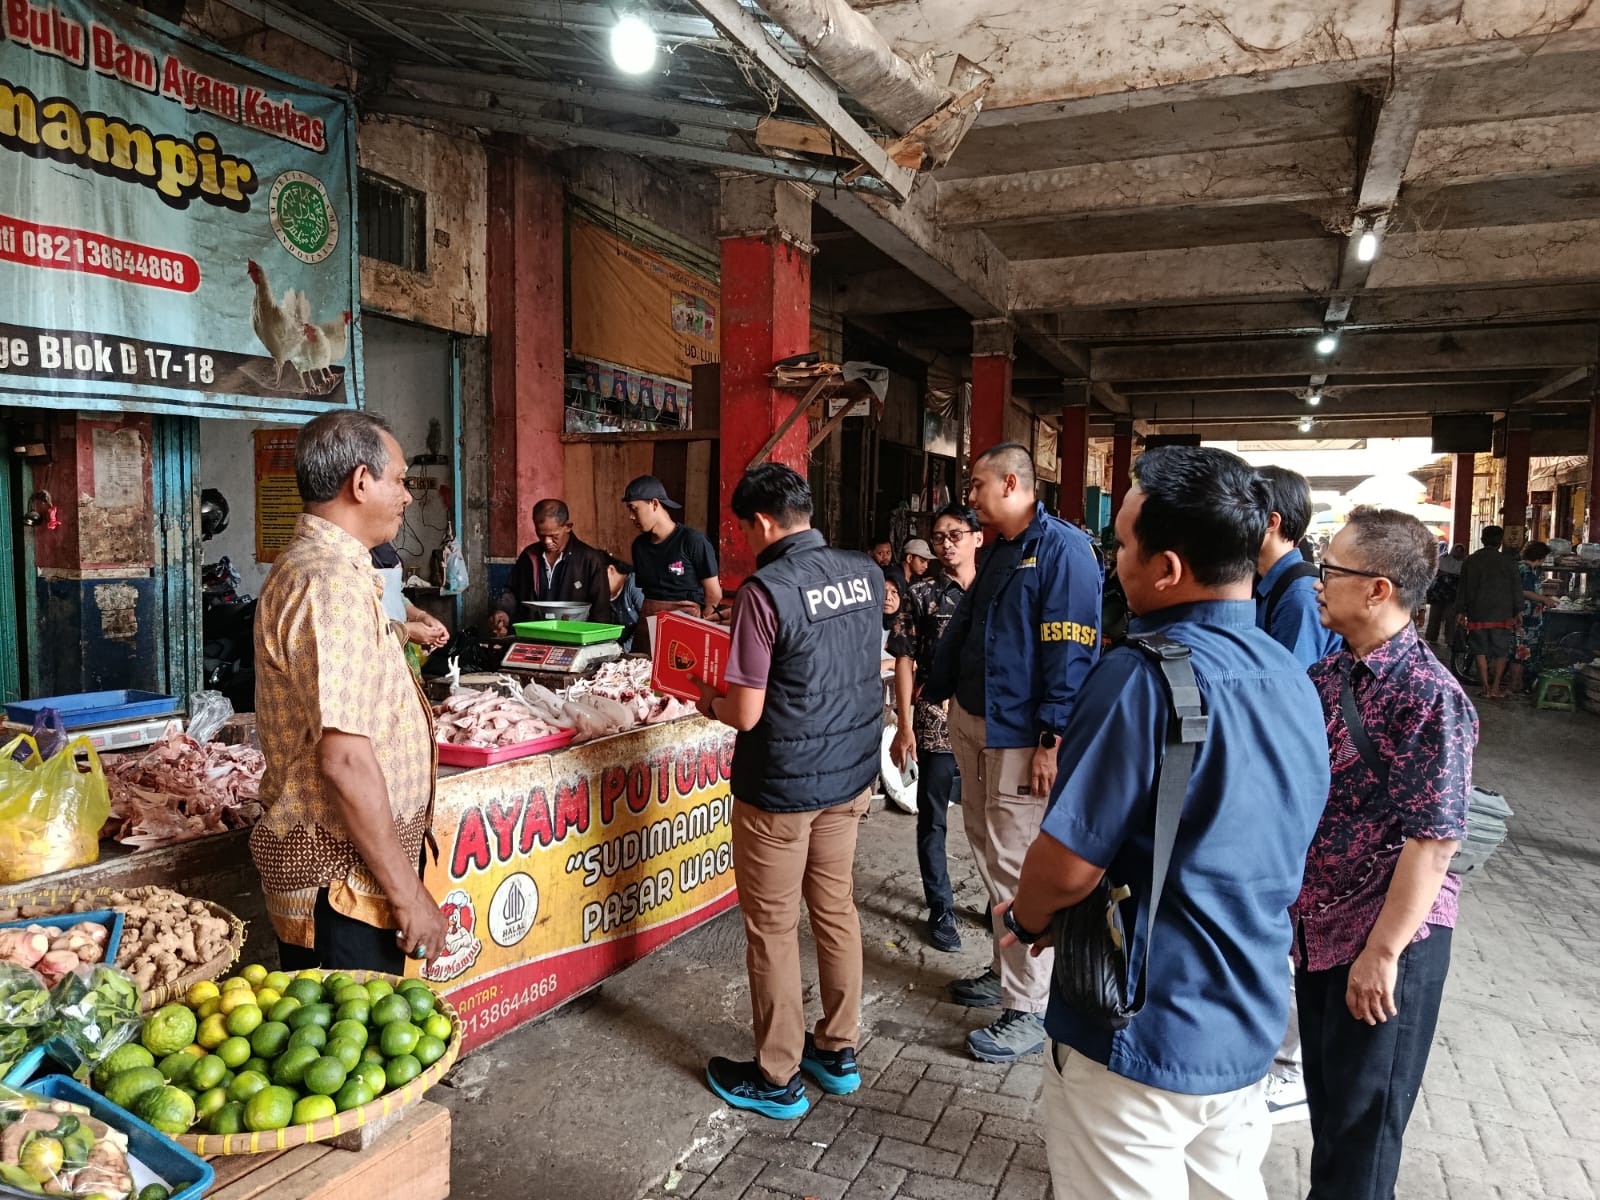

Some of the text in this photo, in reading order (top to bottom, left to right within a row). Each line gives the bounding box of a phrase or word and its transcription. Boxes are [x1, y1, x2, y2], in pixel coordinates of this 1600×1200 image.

[5, 0, 326, 152] Bulu Dan Ayam Karkas
[22, 229, 185, 285] 082138644868
[39, 334, 114, 374] Blok
[119, 342, 138, 375] D
[144, 347, 215, 384] 17-18
[806, 577, 873, 616] POLISI
[449, 772, 591, 880] AYAM
[582, 868, 675, 943] PASAR
[459, 985, 498, 1015] ANTAR
